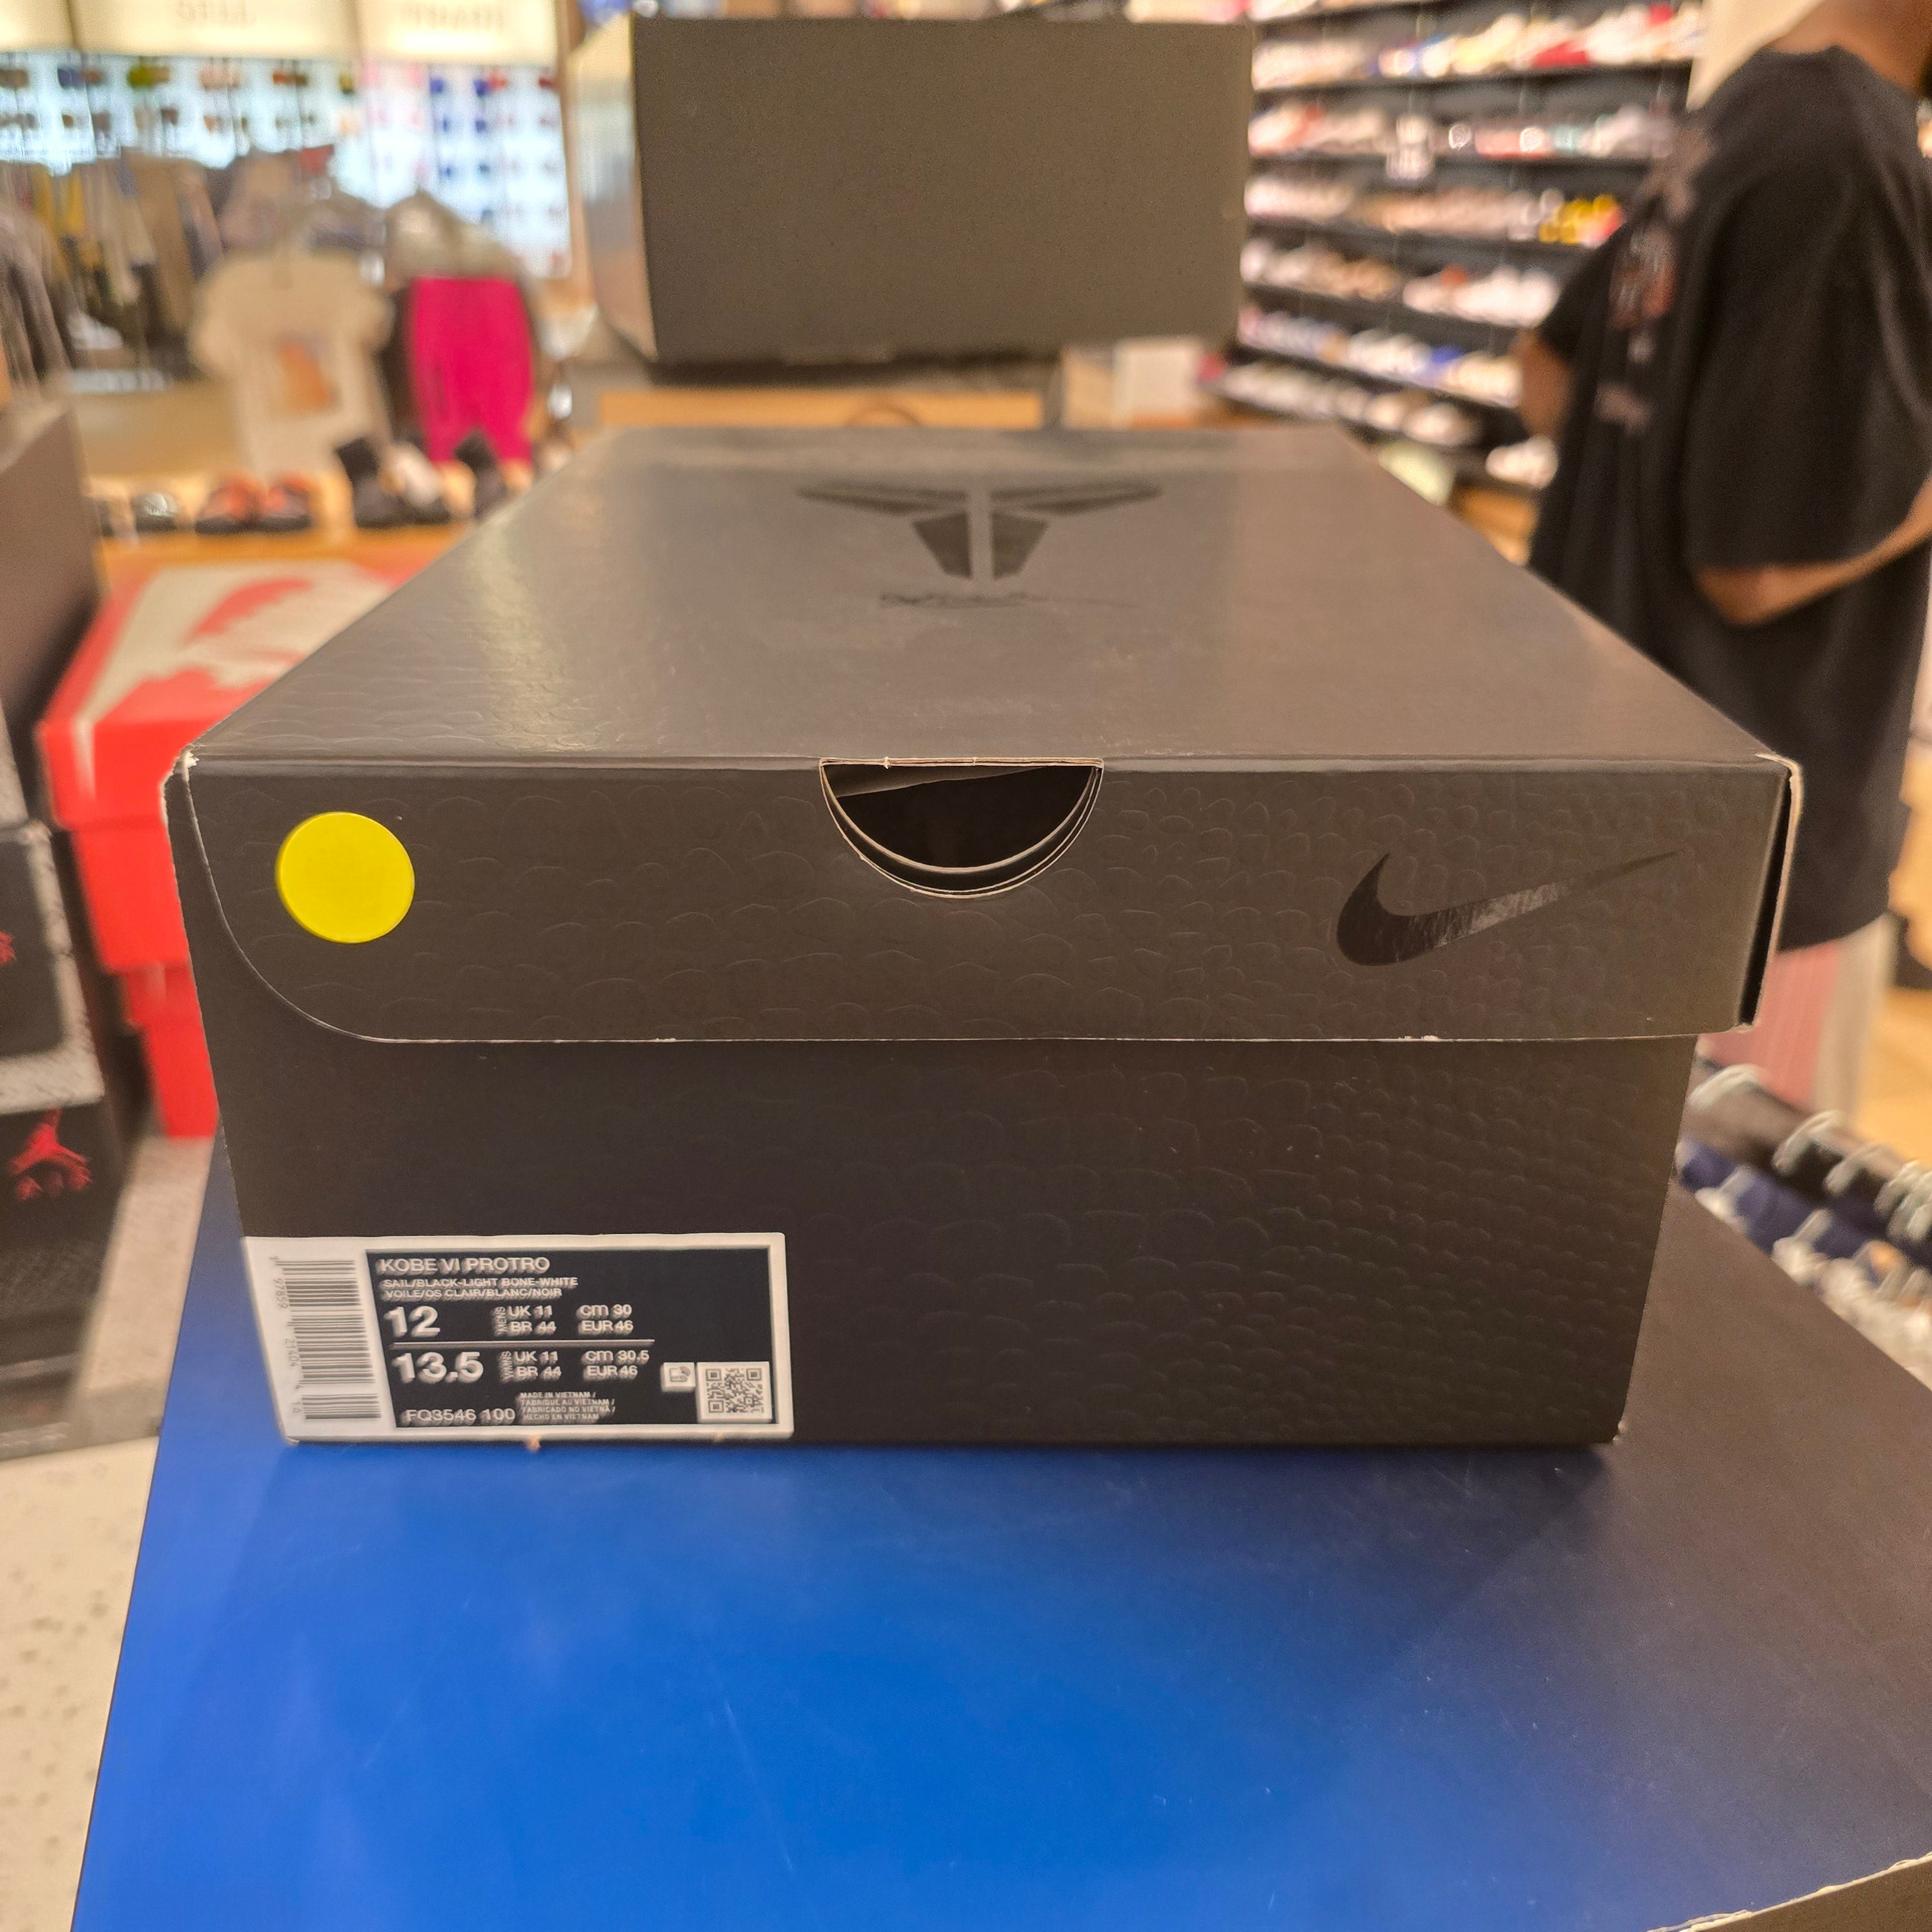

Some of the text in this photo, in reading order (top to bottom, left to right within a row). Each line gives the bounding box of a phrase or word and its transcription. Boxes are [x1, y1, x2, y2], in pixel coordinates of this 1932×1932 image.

[380, 1257, 550, 1274] KOBE VI PROTRO
[382, 1277, 579, 1288] SAIL/BLACK-LIGHT BONE-WHITE
[385, 1288, 562, 1299] VOILE/OS CLAIR/BLANC/NOIR
[508, 1305, 553, 1318] UK 11
[611, 1304, 633, 1316] 30
[386, 1306, 441, 1334] 12
[493, 1306, 508, 1334] MENS
[581, 1320, 633, 1333] EUR 46
[509, 1321, 557, 1333] BR 44
[513, 1351, 559, 1364] UK 11
[617, 1350, 650, 1362] 30.5
[394, 1351, 484, 1381] 13.5
[516, 1366, 562, 1378] BR 44
[586, 1364, 638, 1377] EUR 46
[406, 1408, 515, 1422] FQ3546 100
